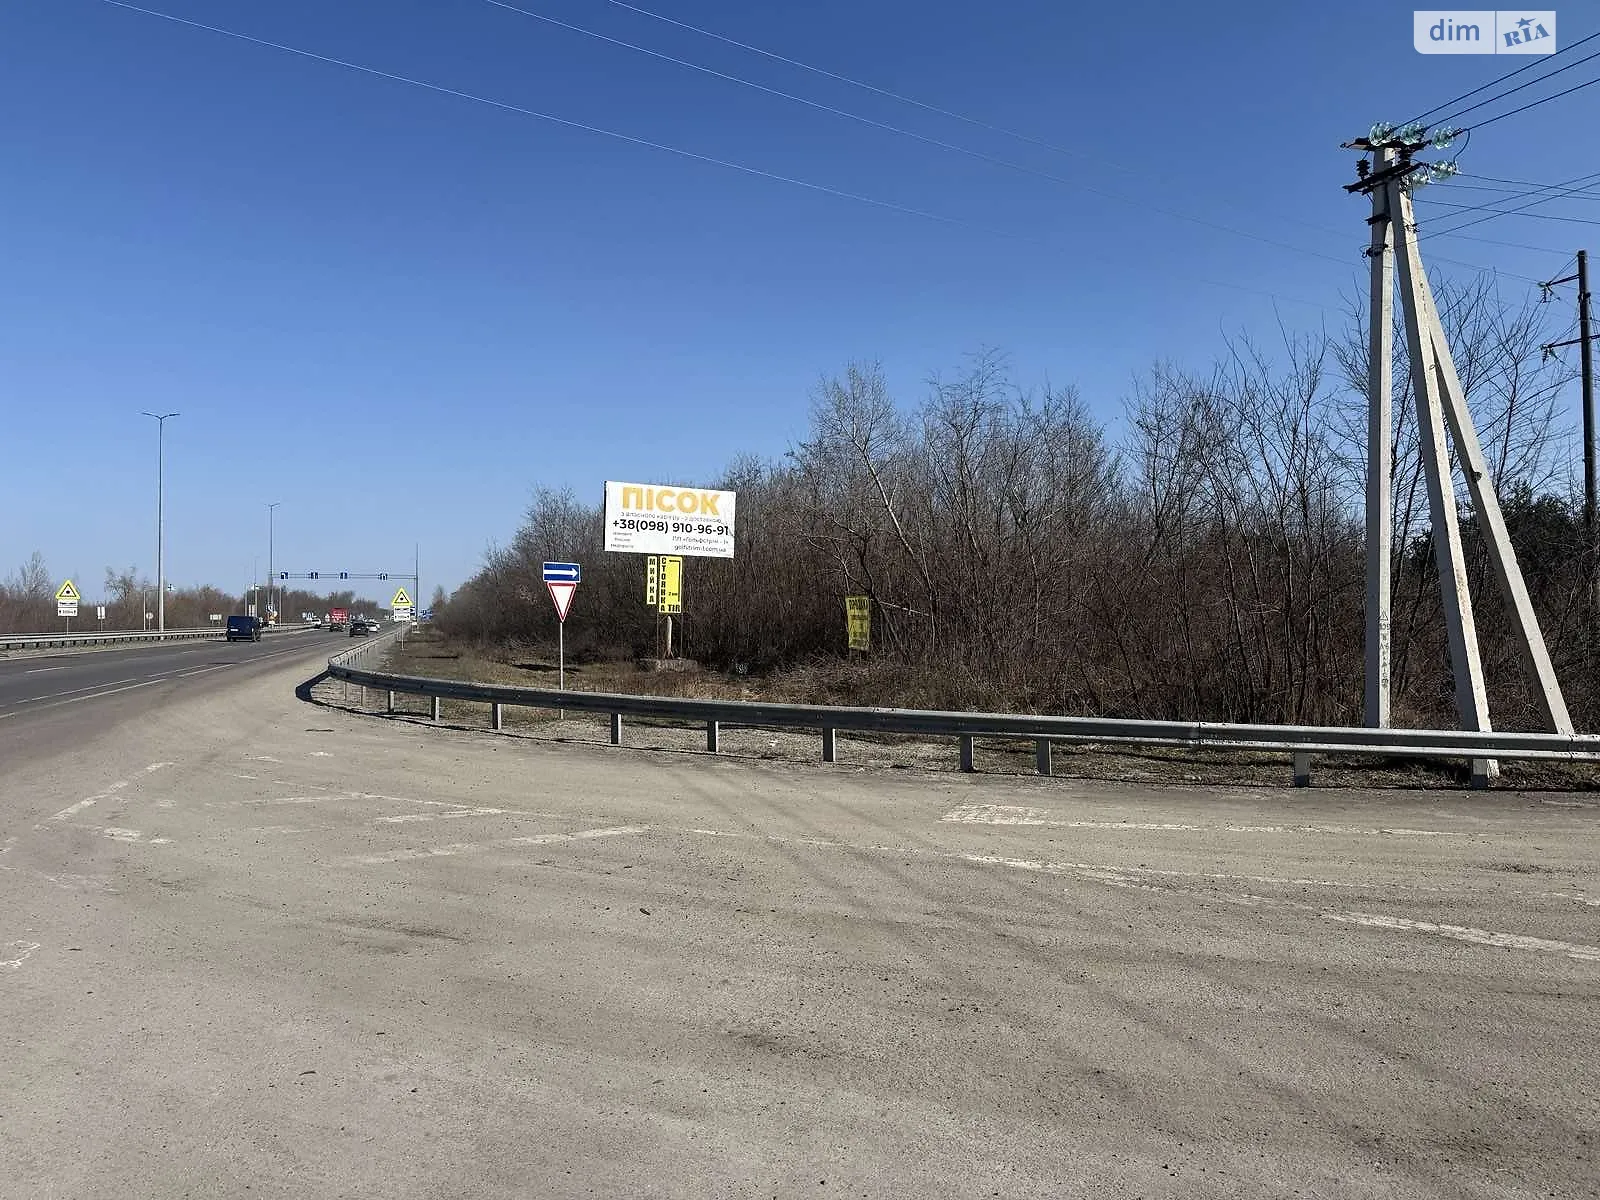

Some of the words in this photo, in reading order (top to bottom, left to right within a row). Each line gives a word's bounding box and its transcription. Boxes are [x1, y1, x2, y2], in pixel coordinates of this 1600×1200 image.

[623, 487, 720, 515] ПІСОК
[613, 518, 668, 533] +38(098)
[672, 522, 729, 536] 910-96-91
[667, 604, 680, 612] TIR
